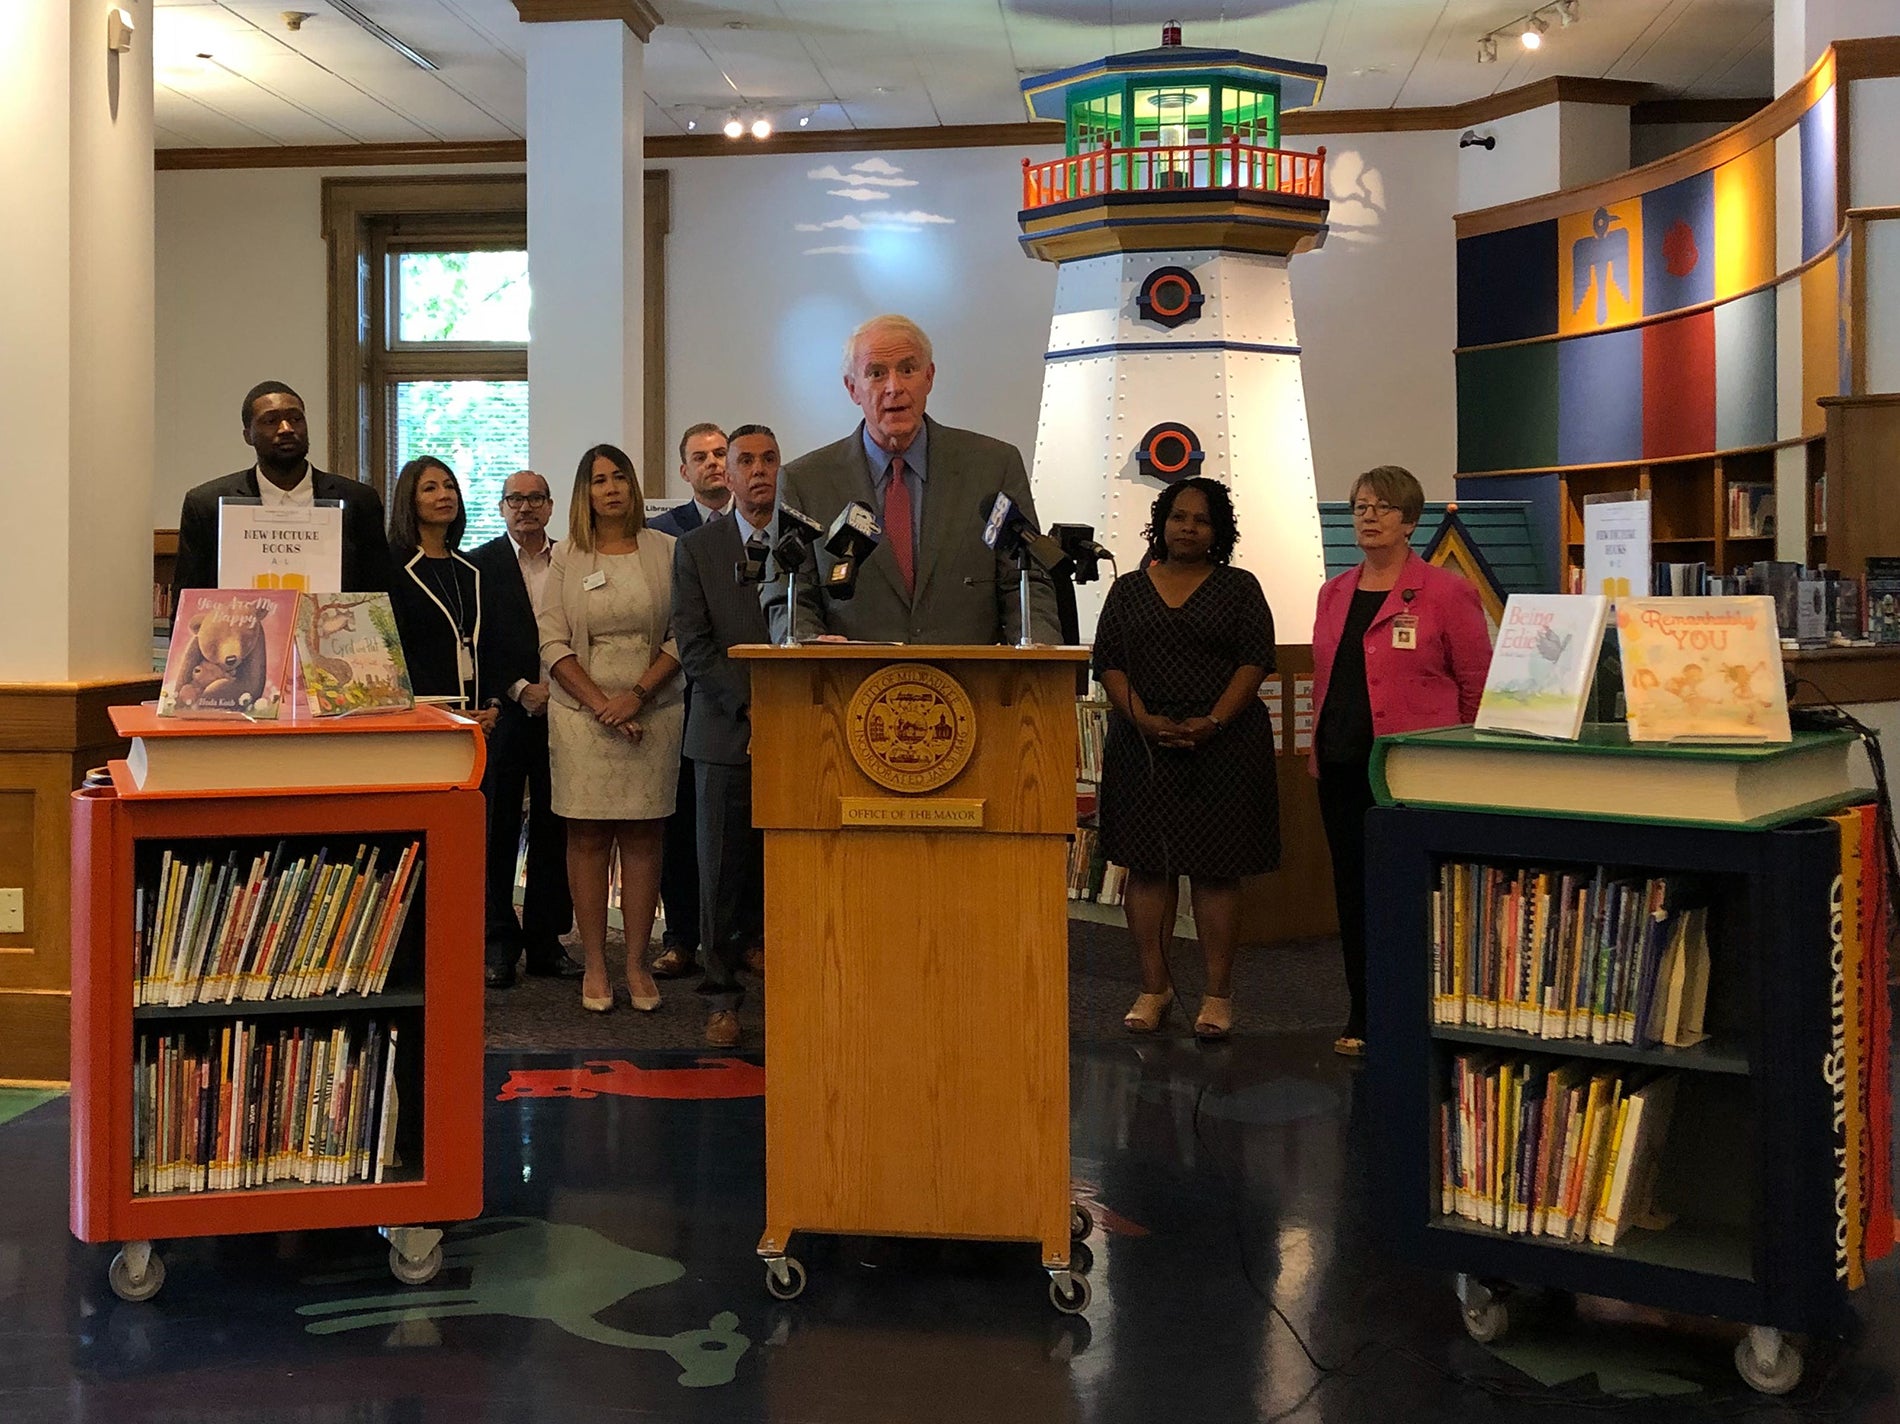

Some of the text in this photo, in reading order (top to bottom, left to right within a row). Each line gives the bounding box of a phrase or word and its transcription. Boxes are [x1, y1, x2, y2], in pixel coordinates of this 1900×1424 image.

[244, 529, 319, 541] NEW PICTURE
[262, 543, 302, 553] BOOKS
[197, 597, 221, 612] You
[1509, 605, 1554, 633] Being
[1501, 628, 1537, 649] Edie
[1671, 629, 1728, 651] YOU
[860, 671, 960, 706] CITY OF MILWAUKEE
[855, 730, 924, 784] INCORPORATED
[927, 764, 948, 782] JAN
[849, 809, 975, 821] OFFICE OF THE MAYOR
